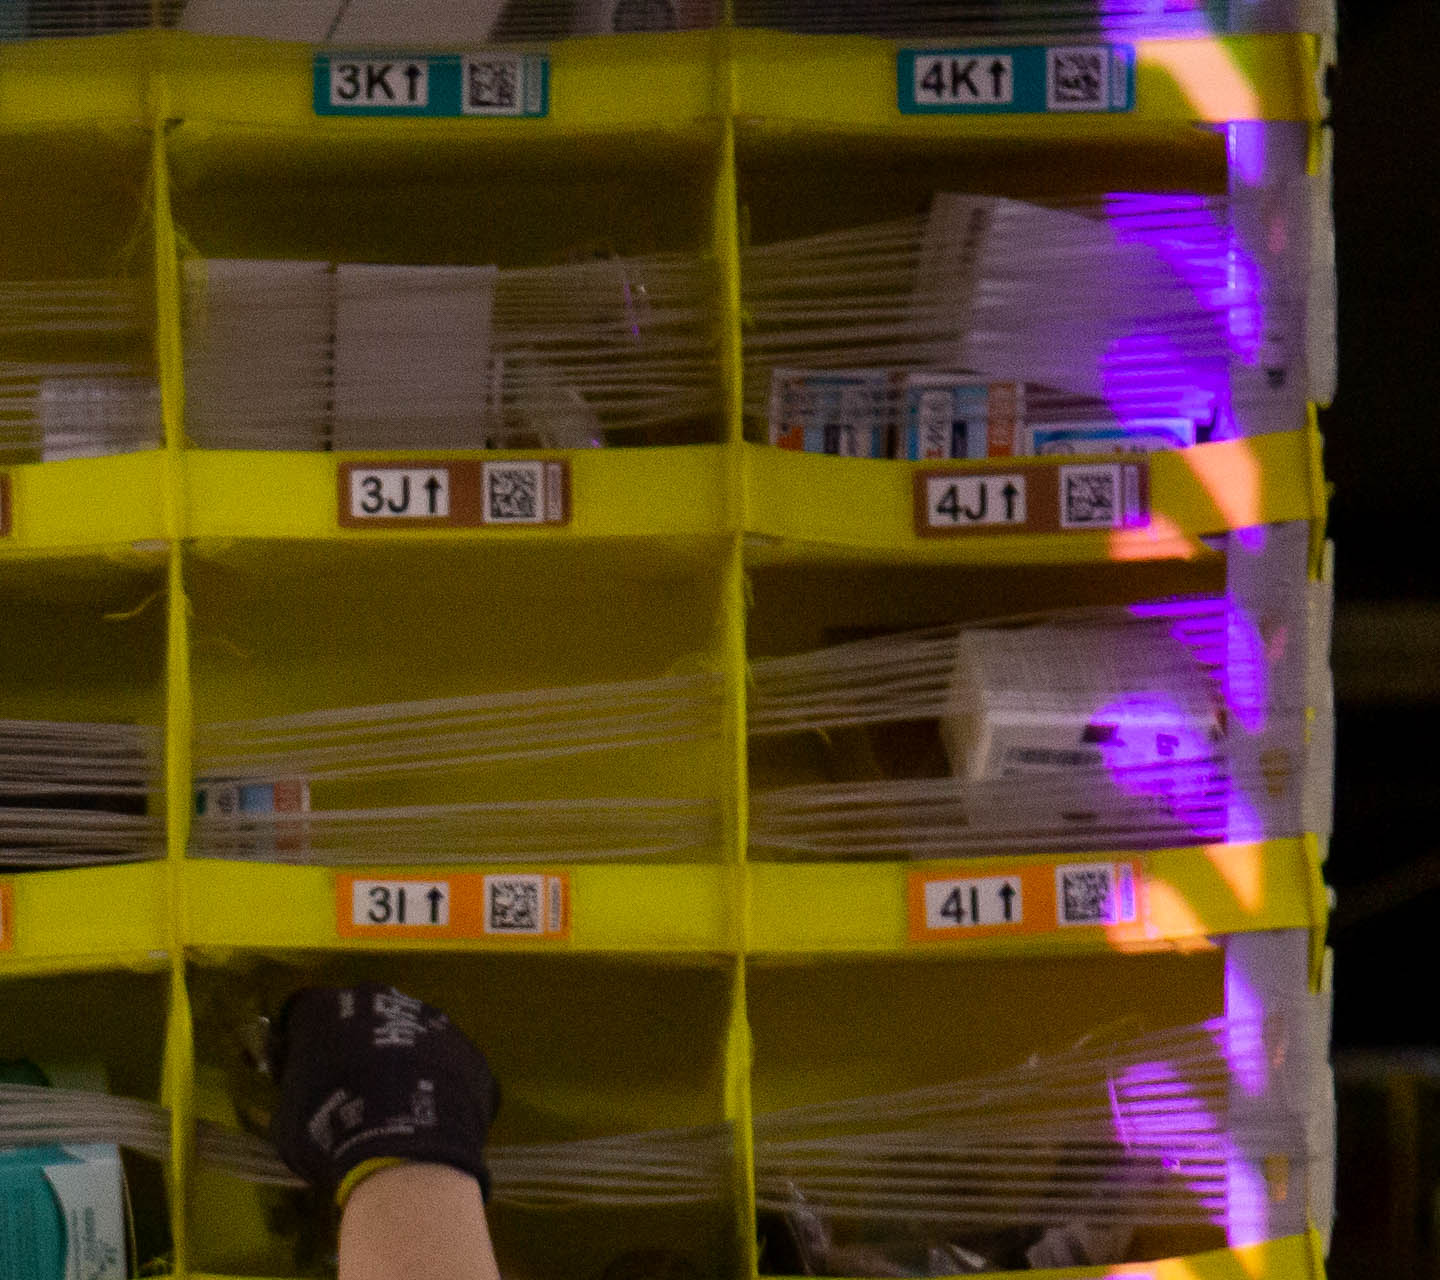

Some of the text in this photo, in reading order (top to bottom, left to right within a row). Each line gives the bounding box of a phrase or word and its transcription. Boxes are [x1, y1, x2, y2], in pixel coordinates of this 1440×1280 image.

[337, 63, 395, 100] 3K
[920, 59, 979, 97] 4K
[361, 475, 411, 516] 3J
[936, 483, 988, 523] 4J
[368, 886, 407, 925] 3I
[940, 886, 980, 926] 4I
